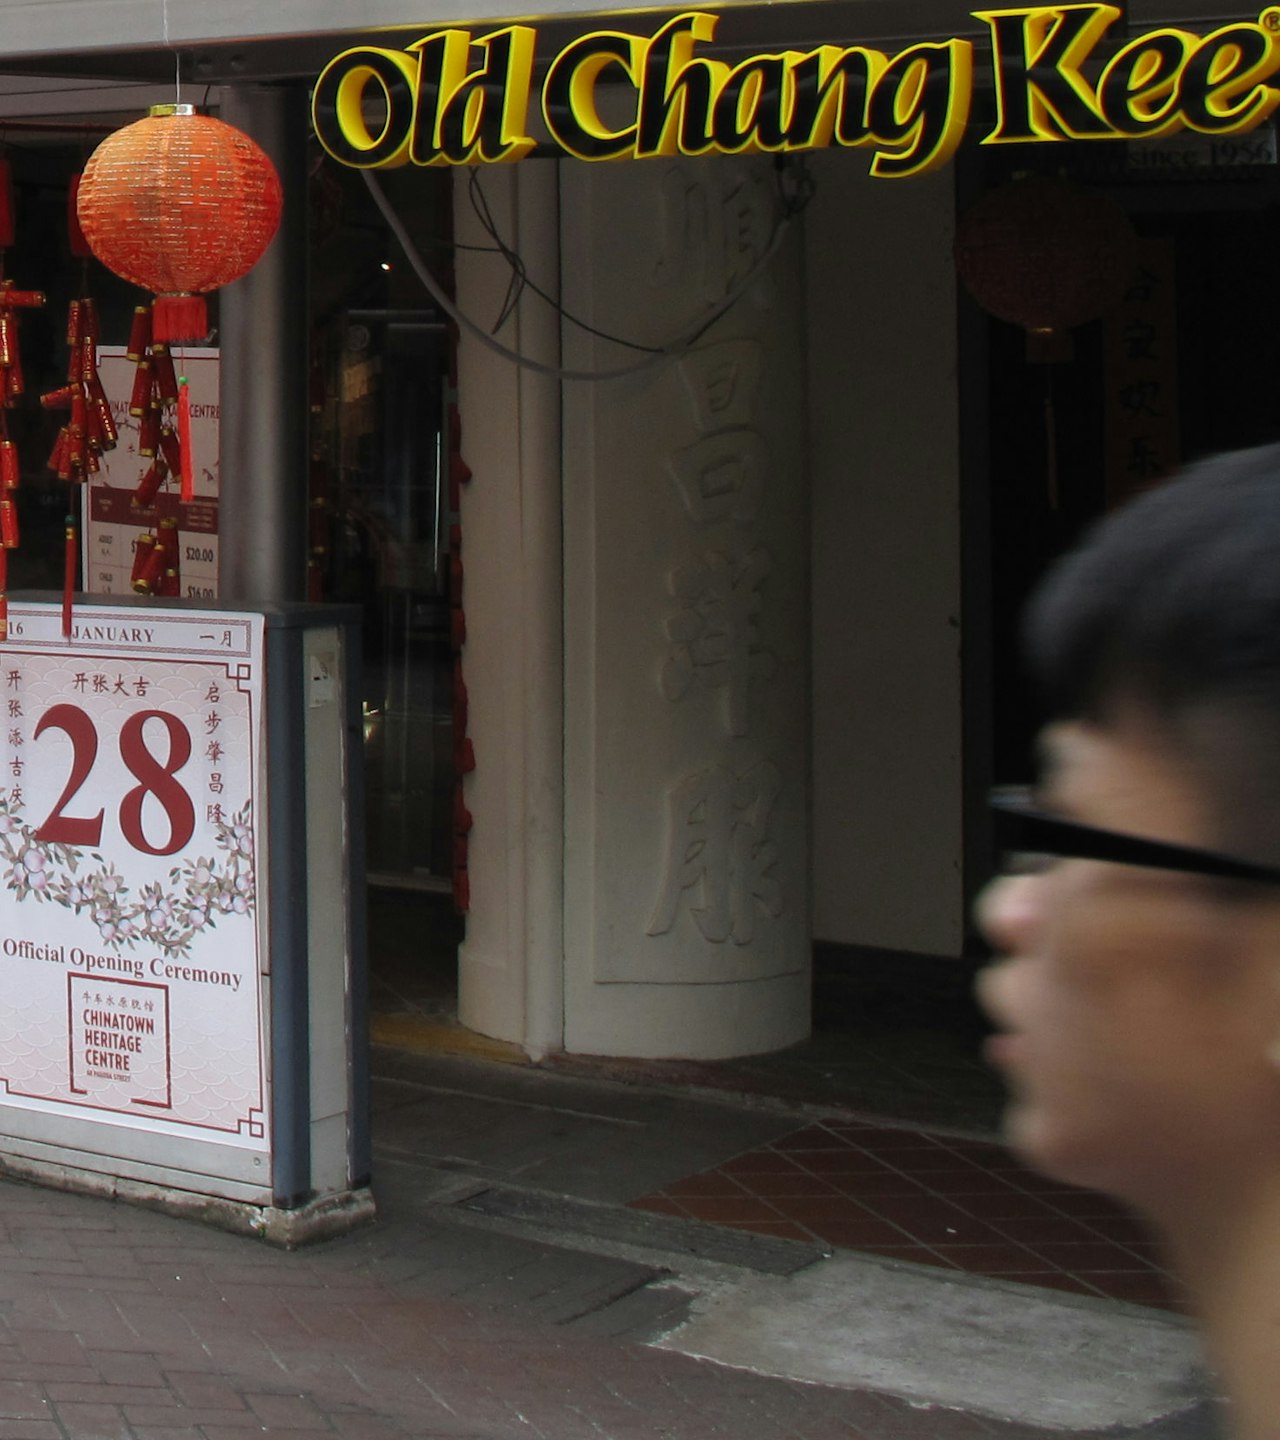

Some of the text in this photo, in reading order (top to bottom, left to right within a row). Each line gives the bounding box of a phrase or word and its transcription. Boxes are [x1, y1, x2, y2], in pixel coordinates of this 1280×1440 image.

[312, 23, 536, 169] Old
[541, 12, 974, 180] Chang
[186, 546, 214, 563] $20.00
[71, 624, 155, 644] JANUARY
[199, 630, 233, 648] 一月
[72, 672, 151, 697] 开张大吉
[33, 703, 197, 857] 28
[3, 938, 243, 992] Official Opening Ceremony
[83, 1008, 155, 1035] CHINATOWN
[84, 1028, 142, 1054] HERITAGE
[85, 1048, 130, 1072] CENTRE
